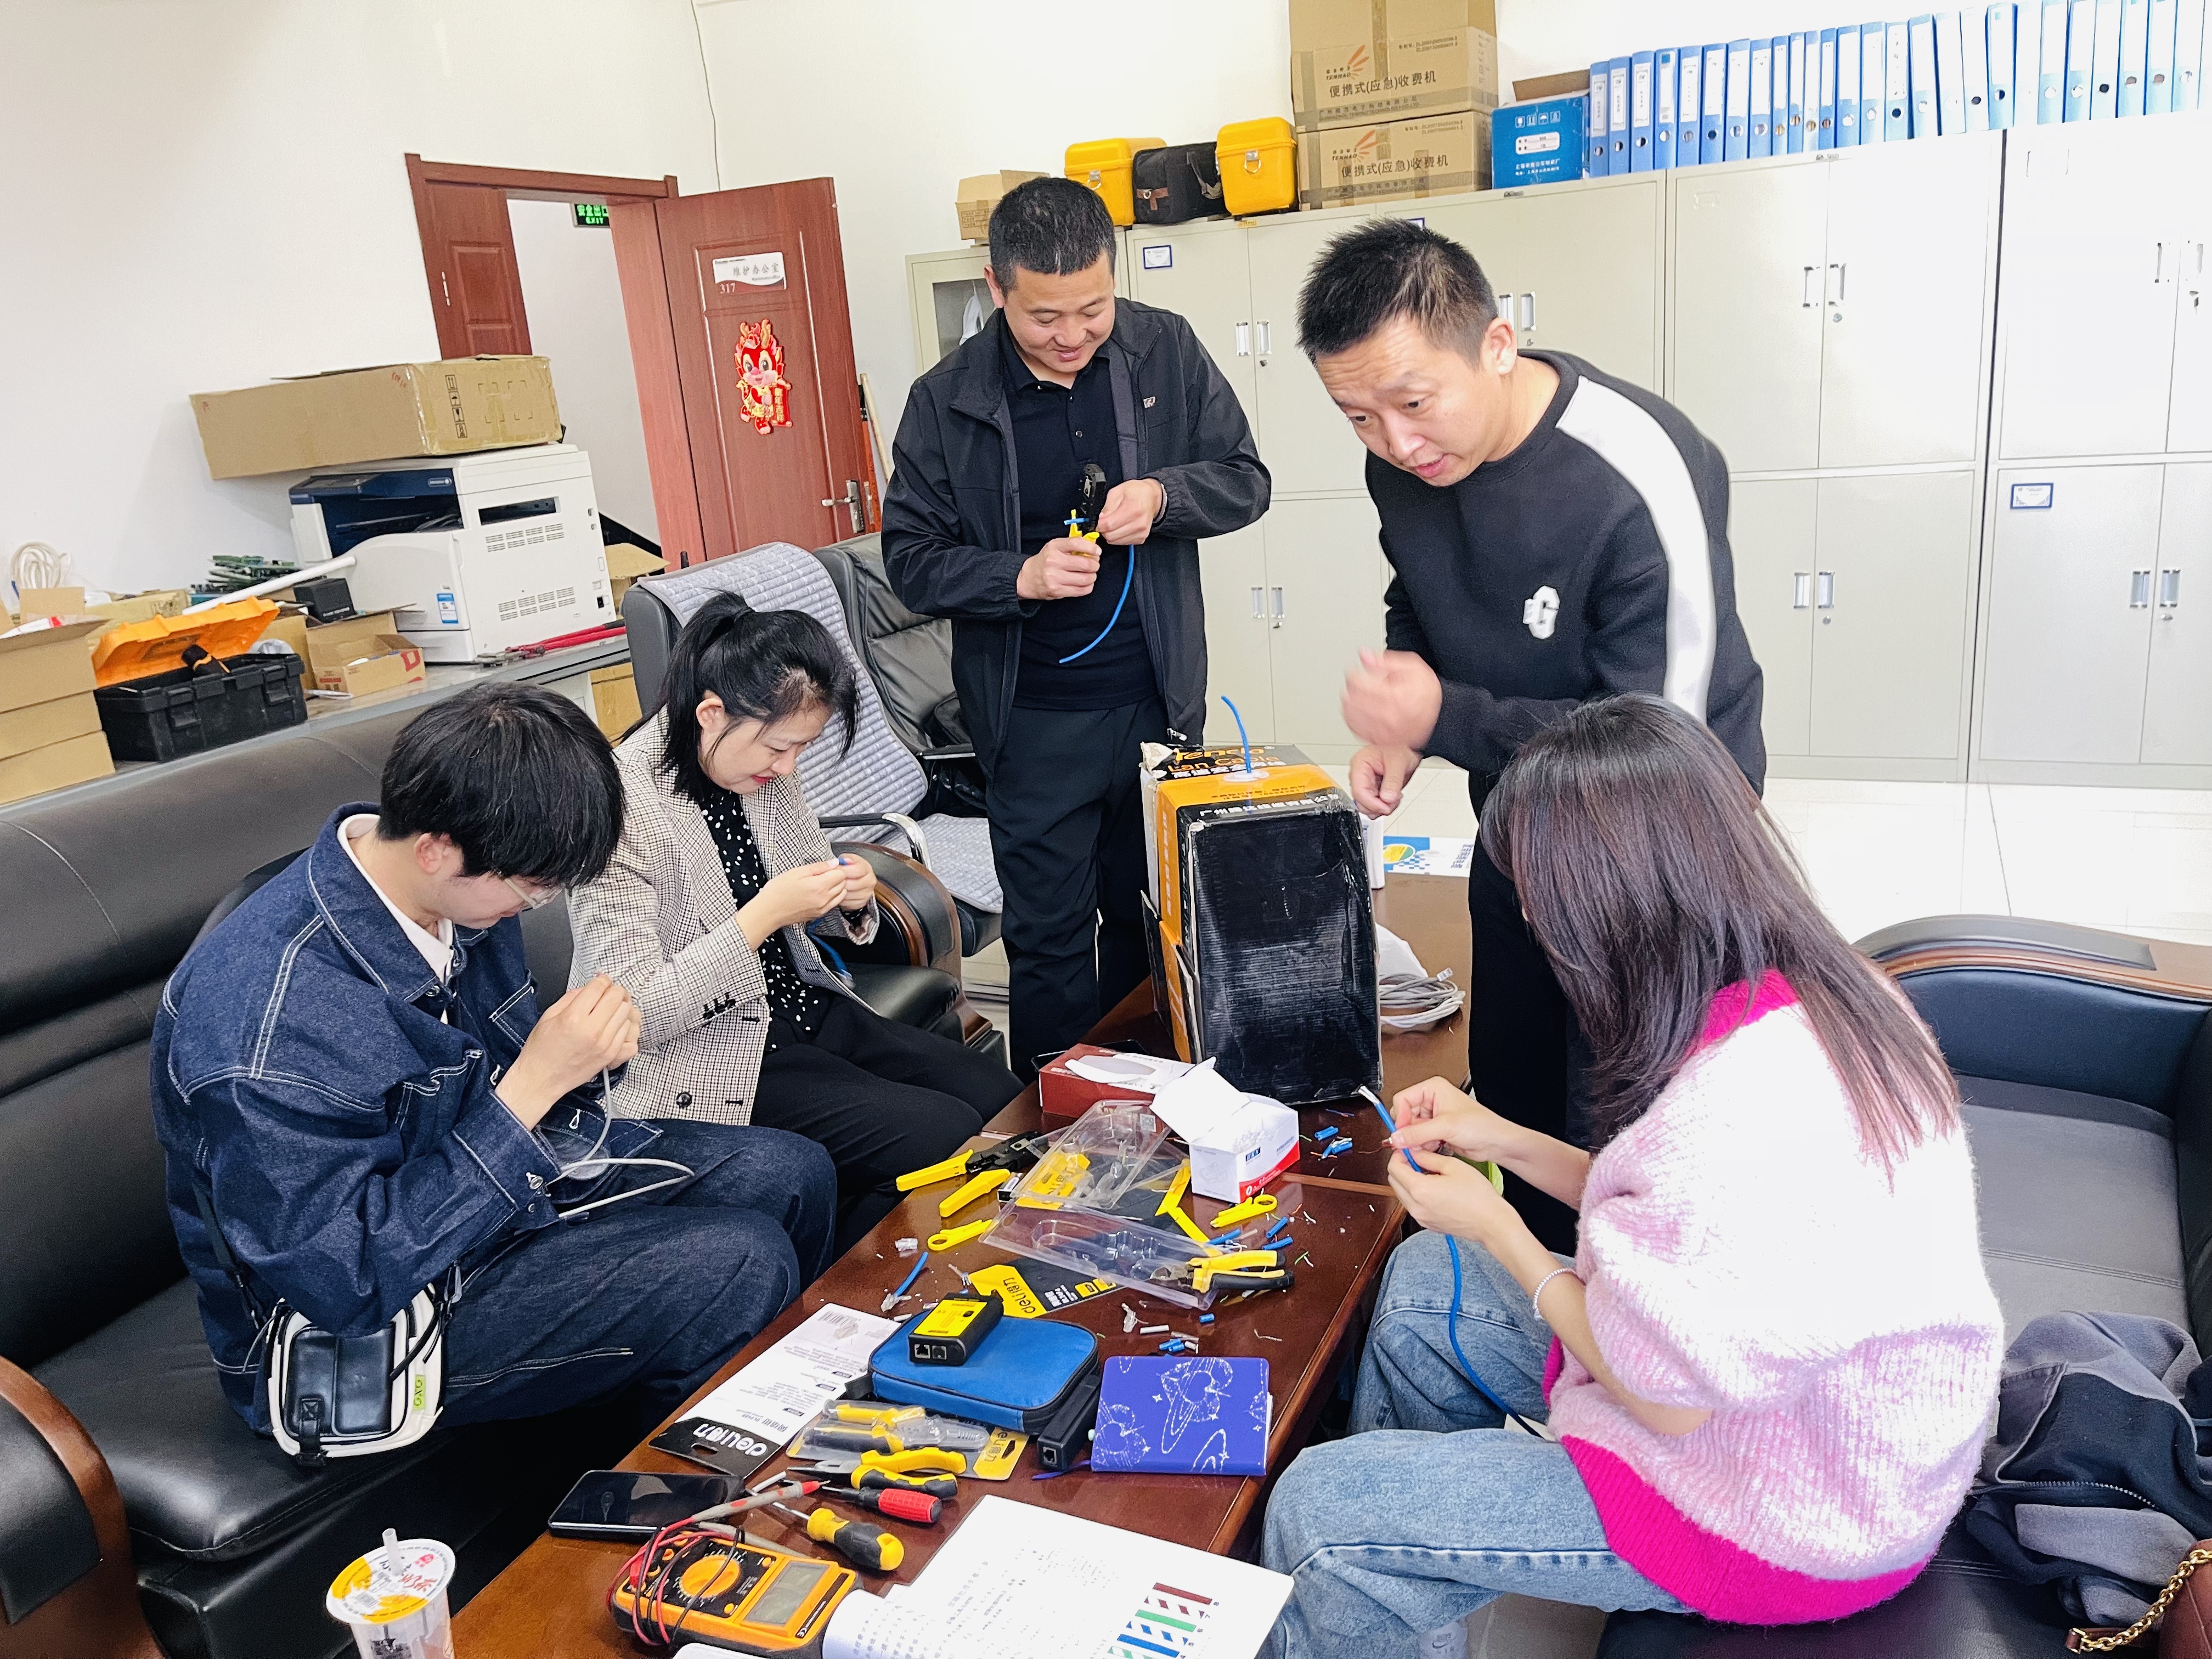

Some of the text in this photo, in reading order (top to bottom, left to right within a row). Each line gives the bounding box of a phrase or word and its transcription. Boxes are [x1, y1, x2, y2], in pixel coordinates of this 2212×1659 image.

[1329, 70, 1436, 98] 便携式(应急)收费机
[1341, 154, 1448, 177] 便携式(应急)收费机
[733, 263, 778, 276] 维护办公室
[720, 283, 735, 294] 317
[1175, 747, 1264, 761] Tenda
